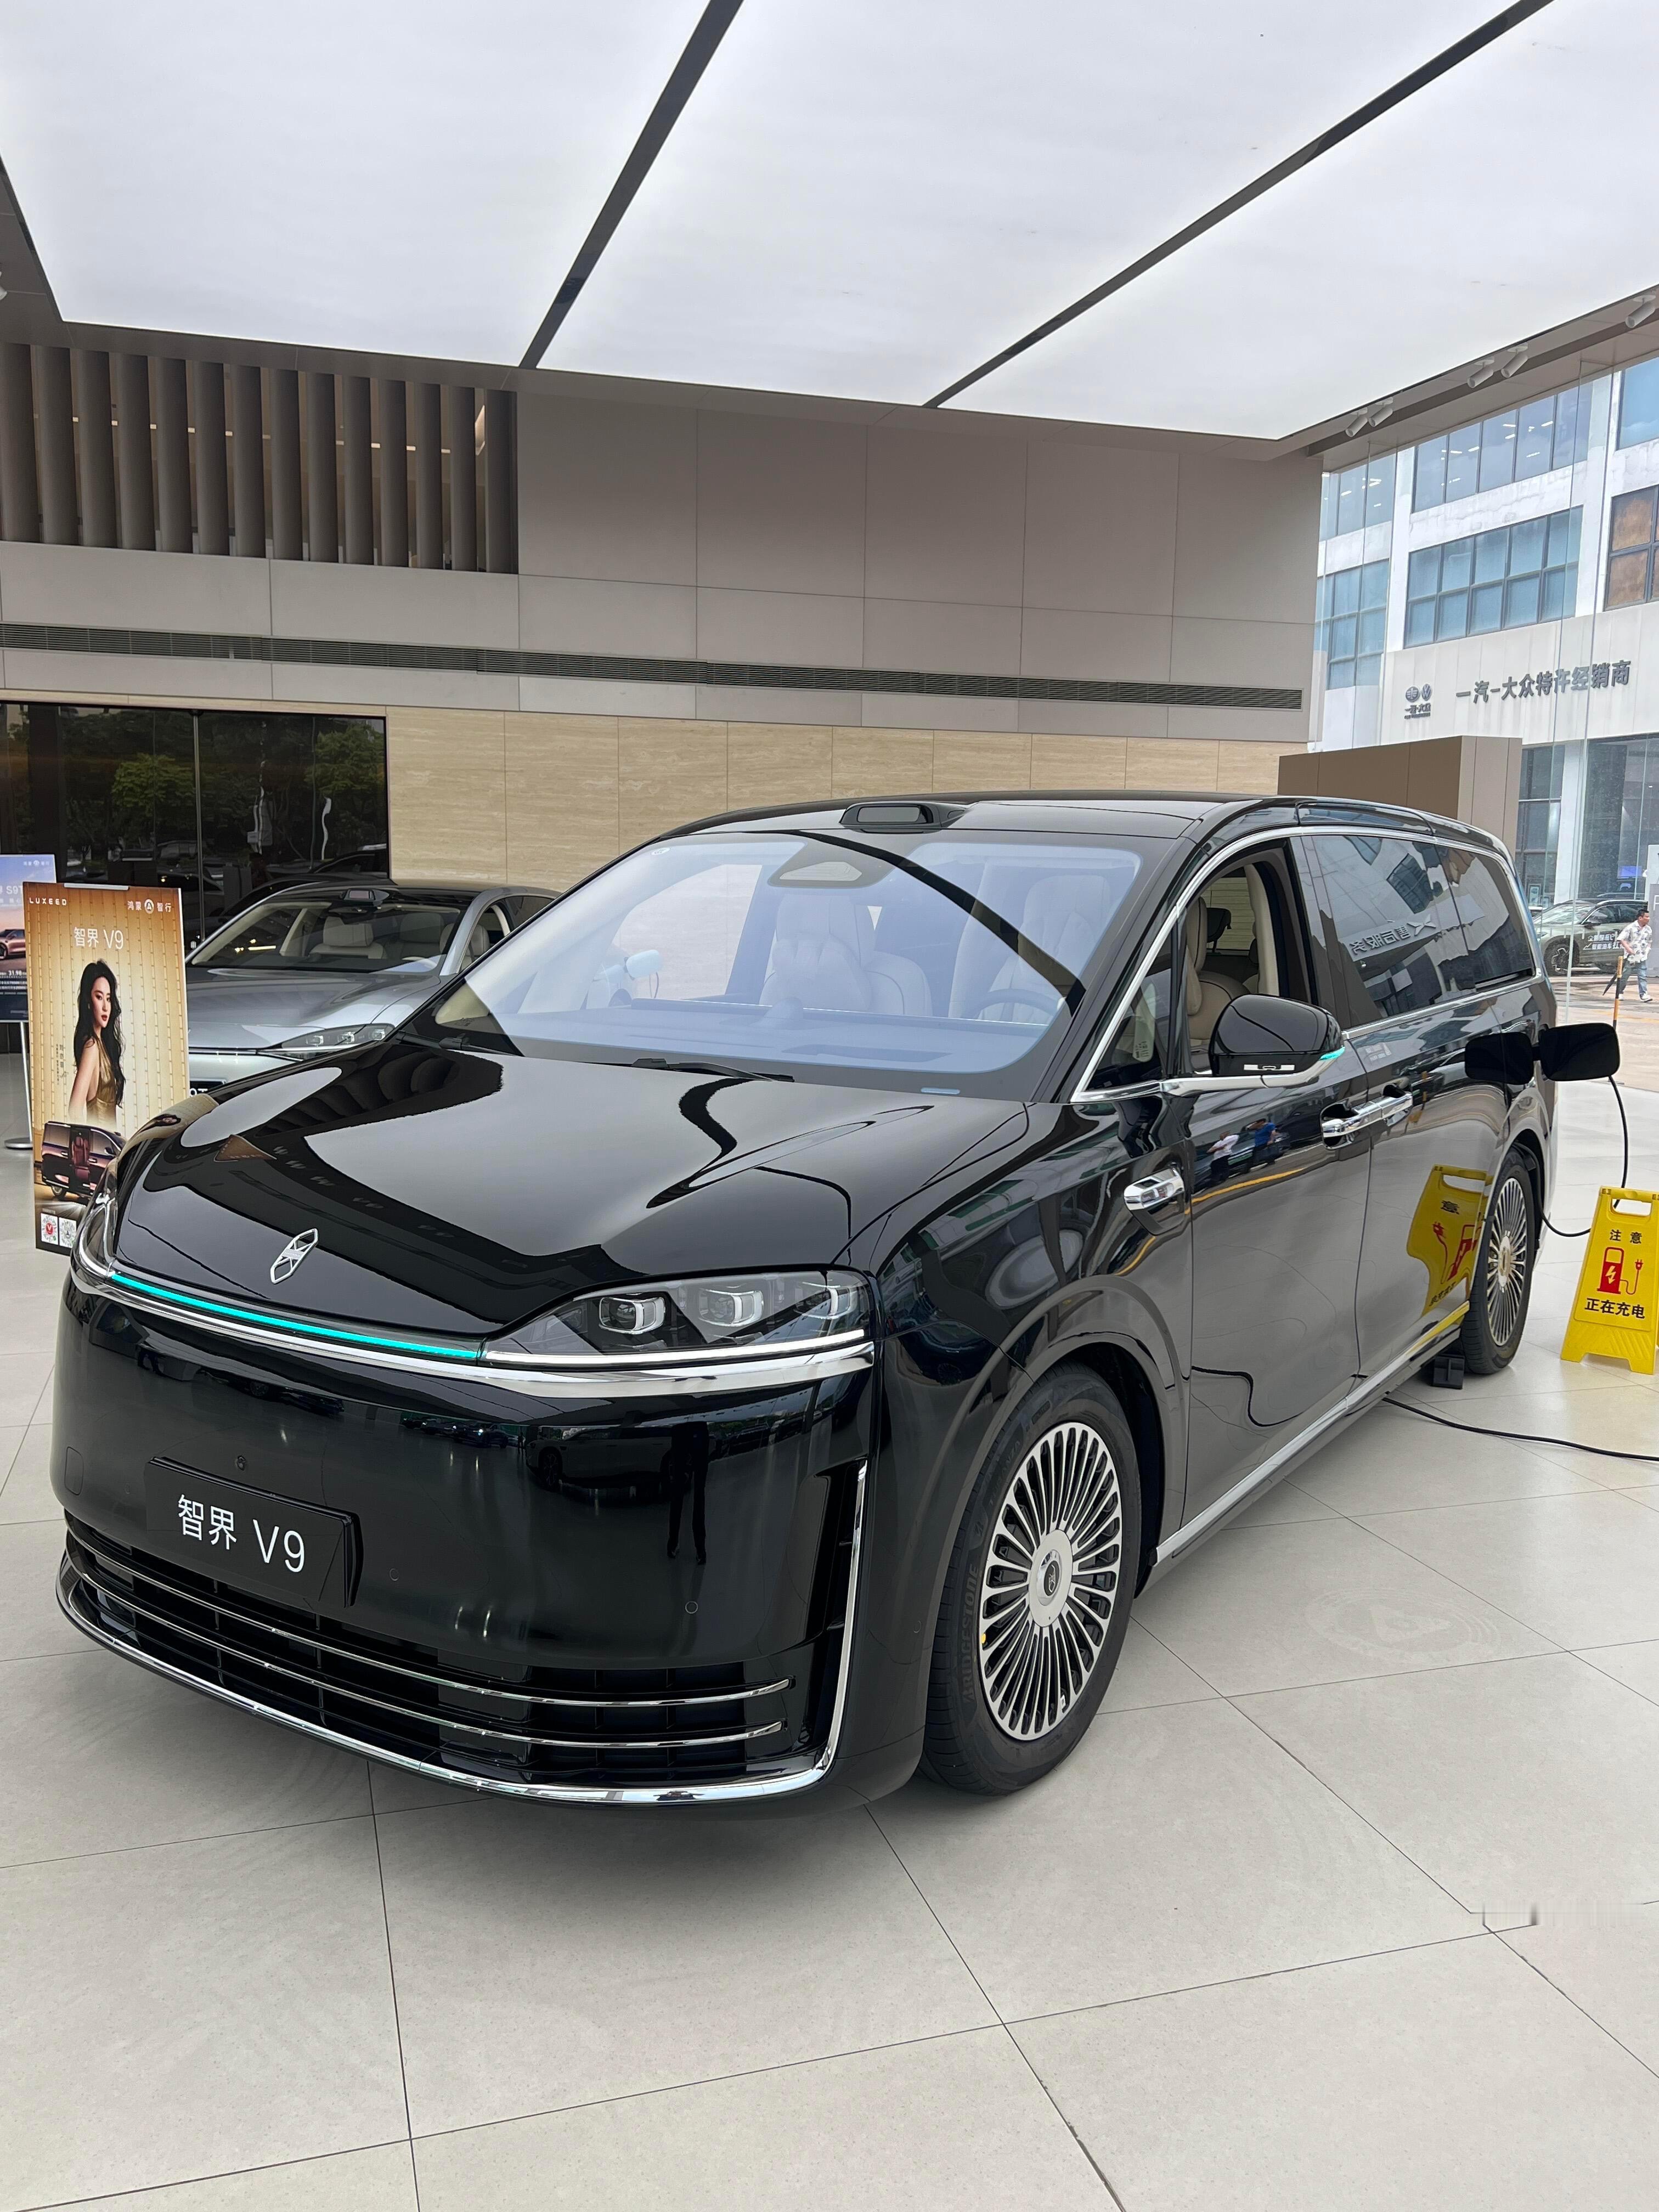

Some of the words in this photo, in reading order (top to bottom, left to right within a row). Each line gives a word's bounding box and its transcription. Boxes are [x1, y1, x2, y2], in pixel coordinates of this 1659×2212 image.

[1455, 659, 1632, 704] 一汽-大众特许经销商
[29, 897, 67, 906] LUXEED
[74, 927, 99, 948] 智界
[103, 930, 124, 950] V9
[1610, 1229, 1643, 1244] 注意
[1584, 1297, 1645, 1319] 正在充电
[178, 1493, 237, 1550] 智界
[252, 1519, 305, 1573] V9
